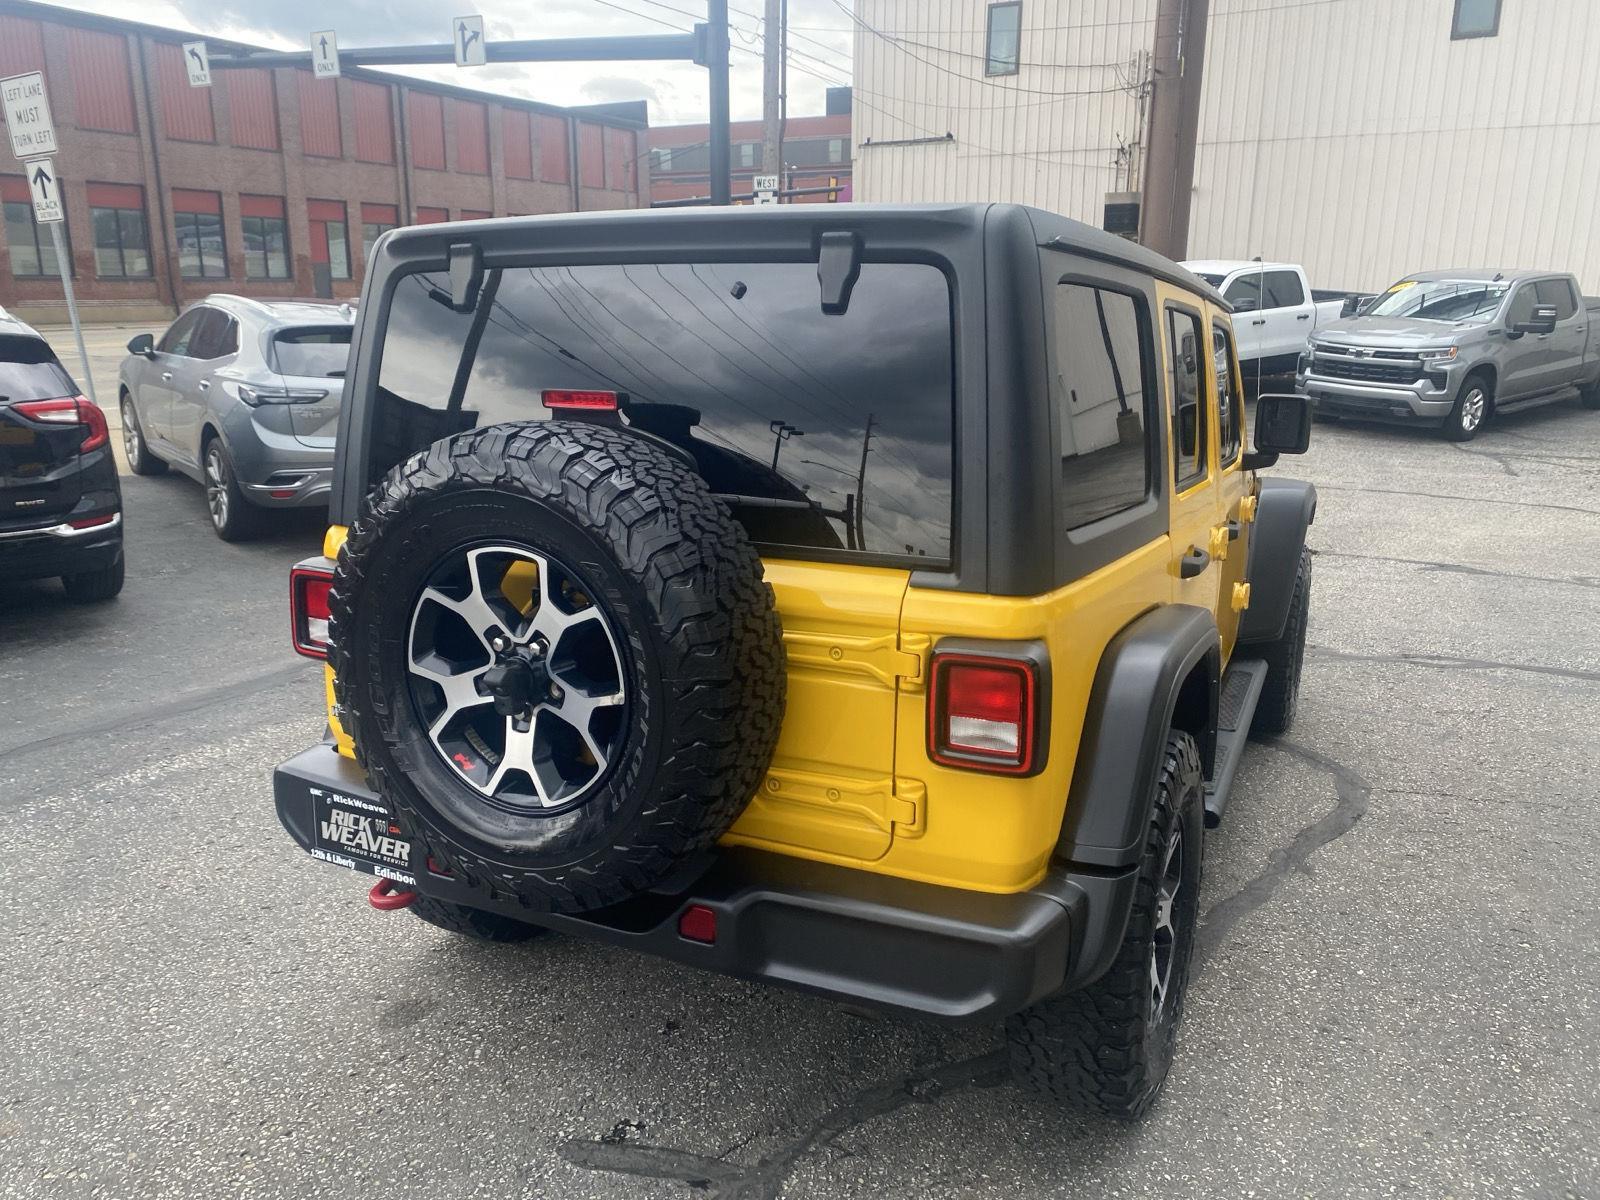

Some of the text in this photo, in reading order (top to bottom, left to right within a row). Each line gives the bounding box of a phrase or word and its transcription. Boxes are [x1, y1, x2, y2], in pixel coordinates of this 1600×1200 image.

[317, 63, 336, 73] ONLY
[191, 73, 208, 83] ONLY
[5, 83, 42, 101] LEFT LANE
[15, 106, 39, 124] MUST
[14, 130, 52, 147] TURN LEFT
[756, 178, 775, 188] WEST
[36, 200, 58, 211] BLACK
[330, 808, 373, 833] RICK
[321, 820, 411, 861] WEAVER
[310, 848, 356, 870] 12th & Liberty
[343, 845, 409, 867] FAMOUS FOR SERVICE
